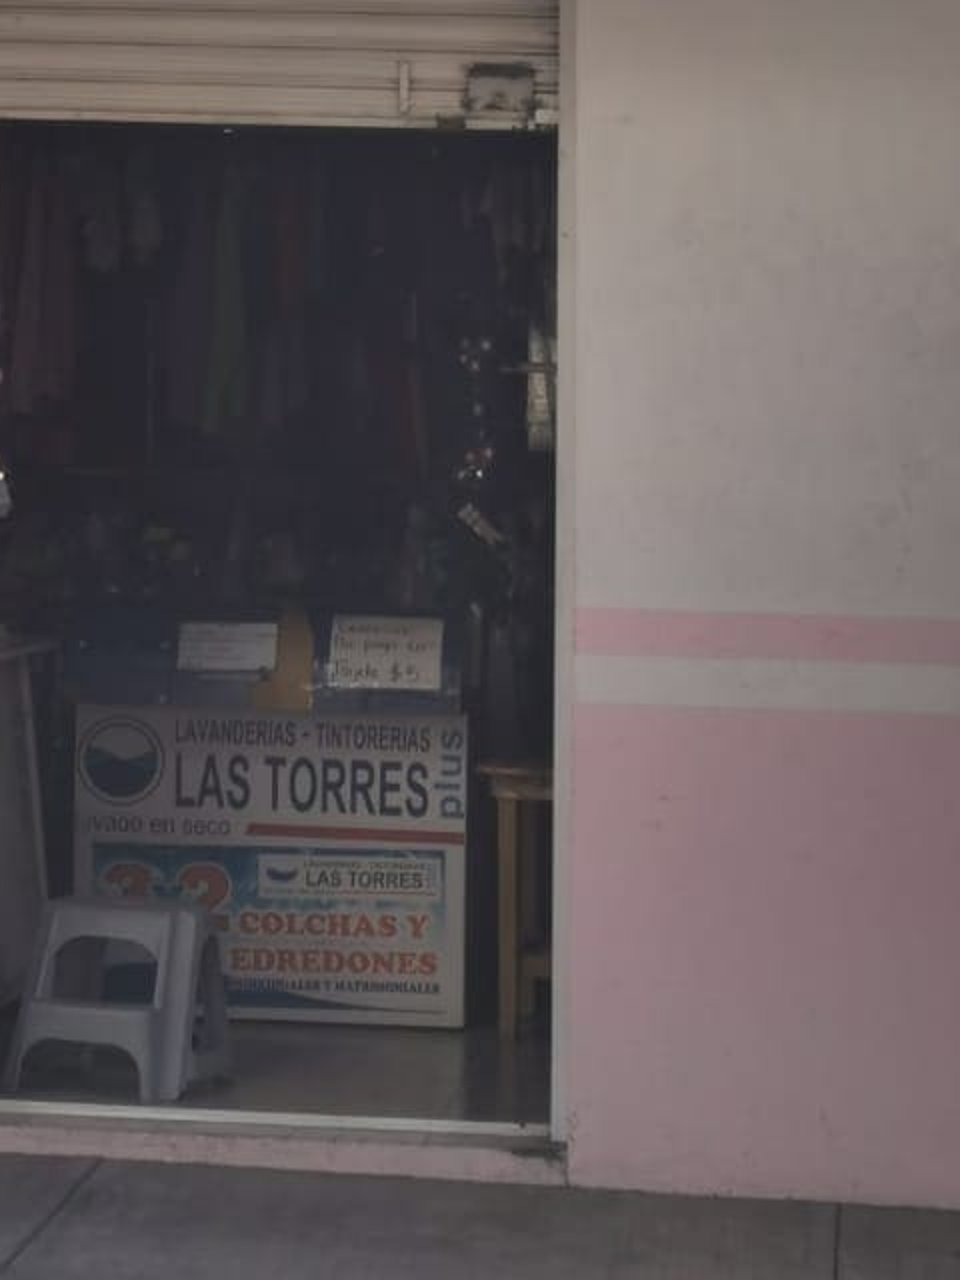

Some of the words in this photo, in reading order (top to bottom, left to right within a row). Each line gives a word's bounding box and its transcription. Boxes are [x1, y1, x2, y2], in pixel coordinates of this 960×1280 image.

[175, 751, 251, 810] LAS
[263, 754, 430, 819] TORRES
[433, 729, 465, 819] plus
[304, 870, 342, 889] LAS
[350, 871, 424, 890] TORRES
[239, 911, 398, 938] COLCHAS
[406, 913, 430, 940] Y
[229, 947, 439, 976] EDREDONES
